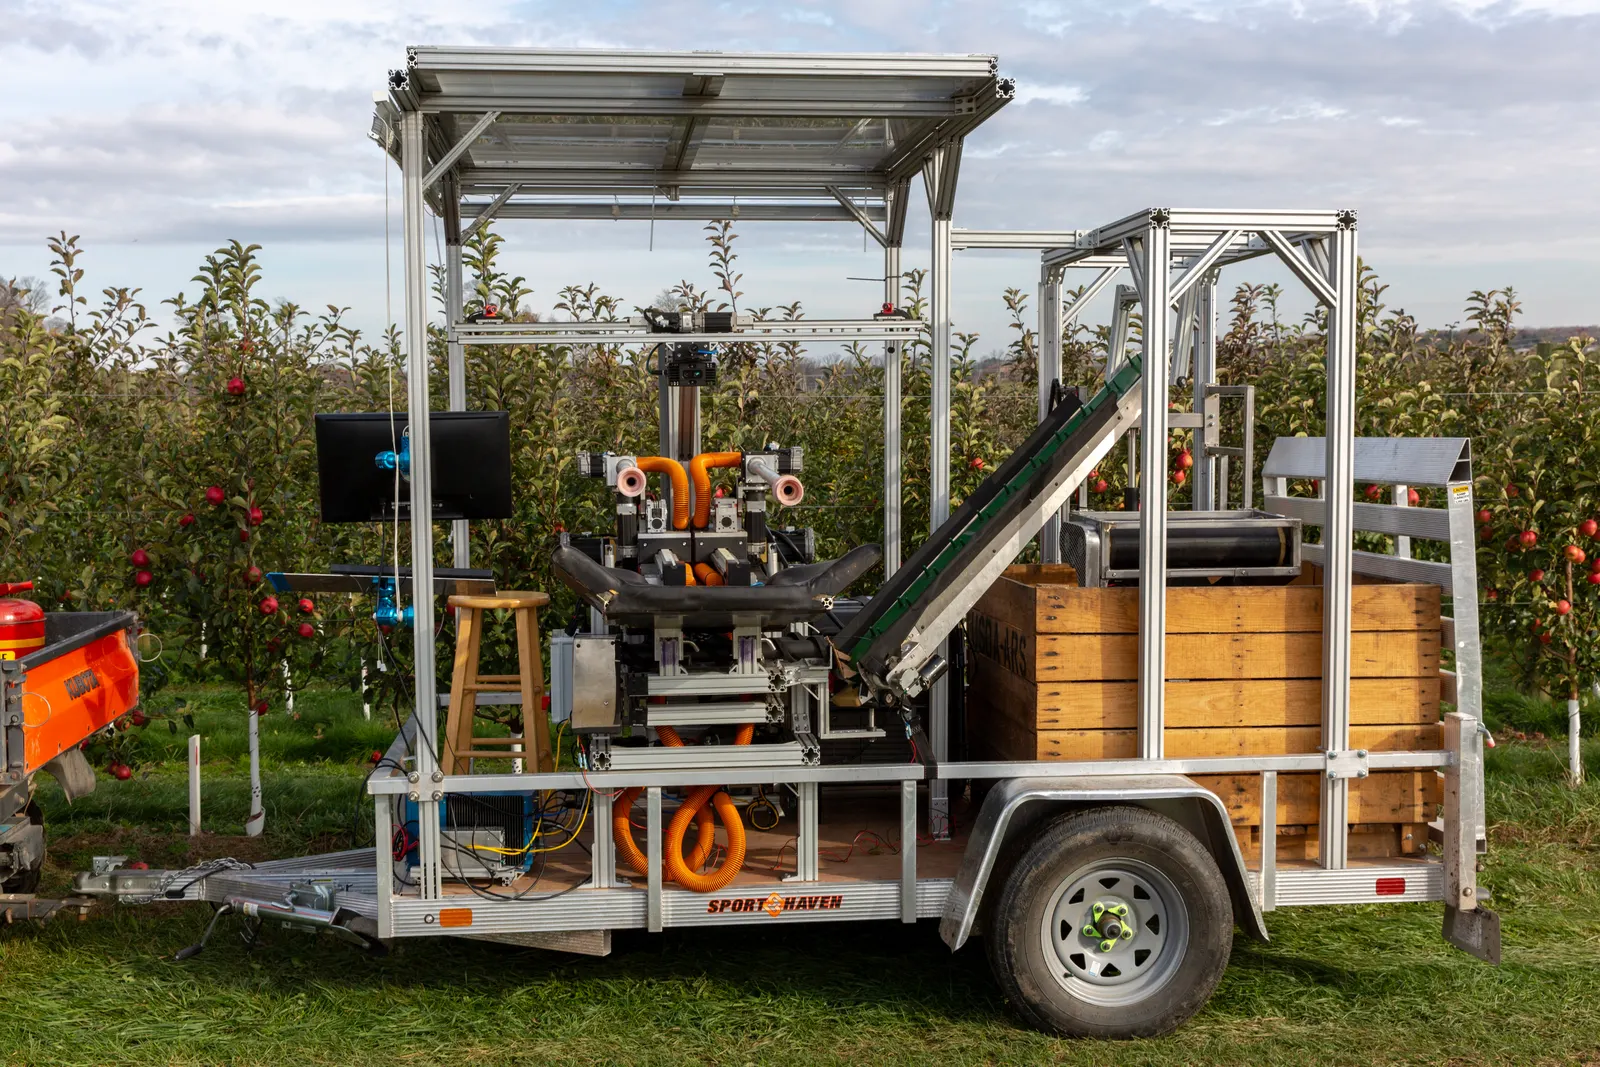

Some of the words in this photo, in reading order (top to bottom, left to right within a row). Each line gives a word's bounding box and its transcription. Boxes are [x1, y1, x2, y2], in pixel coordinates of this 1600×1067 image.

[64, 667, 100, 701] KUBOTA
[707, 898, 768, 913] SPORT
[783, 895, 844, 910] HAVEN
